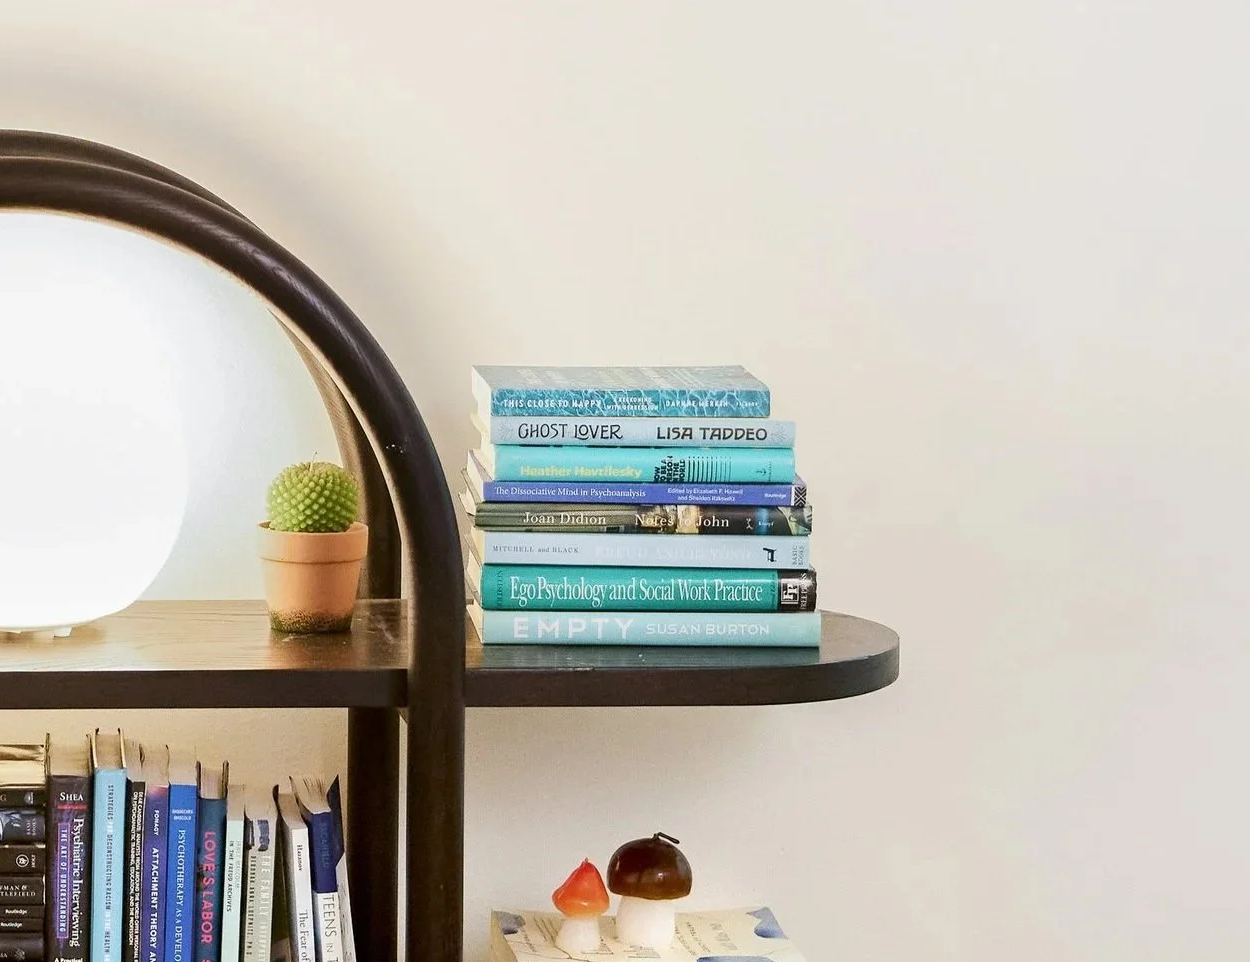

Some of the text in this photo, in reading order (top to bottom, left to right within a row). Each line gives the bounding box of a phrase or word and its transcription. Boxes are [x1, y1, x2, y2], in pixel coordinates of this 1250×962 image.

[503, 399, 601, 408] THIS CLOSE TO HAPPY
[518, 423, 623, 440] GHOST LOVER
[657, 427, 768, 441] LISA TADDEO
[495, 487, 646, 498] The Dissociative Mind in Psychoanalysis
[523, 512, 607, 525] Joan Didion
[635, 514, 730, 527] Notes to John
[510, 576, 536, 608] Ego
[537, 576, 607, 608] Psychology
[609, 577, 636, 601] and
[639, 577, 674, 601] Social
[677, 579, 712, 601] Work
[715, 580, 763, 601] Practice
[514, 617, 634, 639] EMPTY
[646, 623, 769, 634] SUSAN BURTON
[151, 848, 159, 909] ATTACHMENT
[150, 912, 158, 948] THEORY
